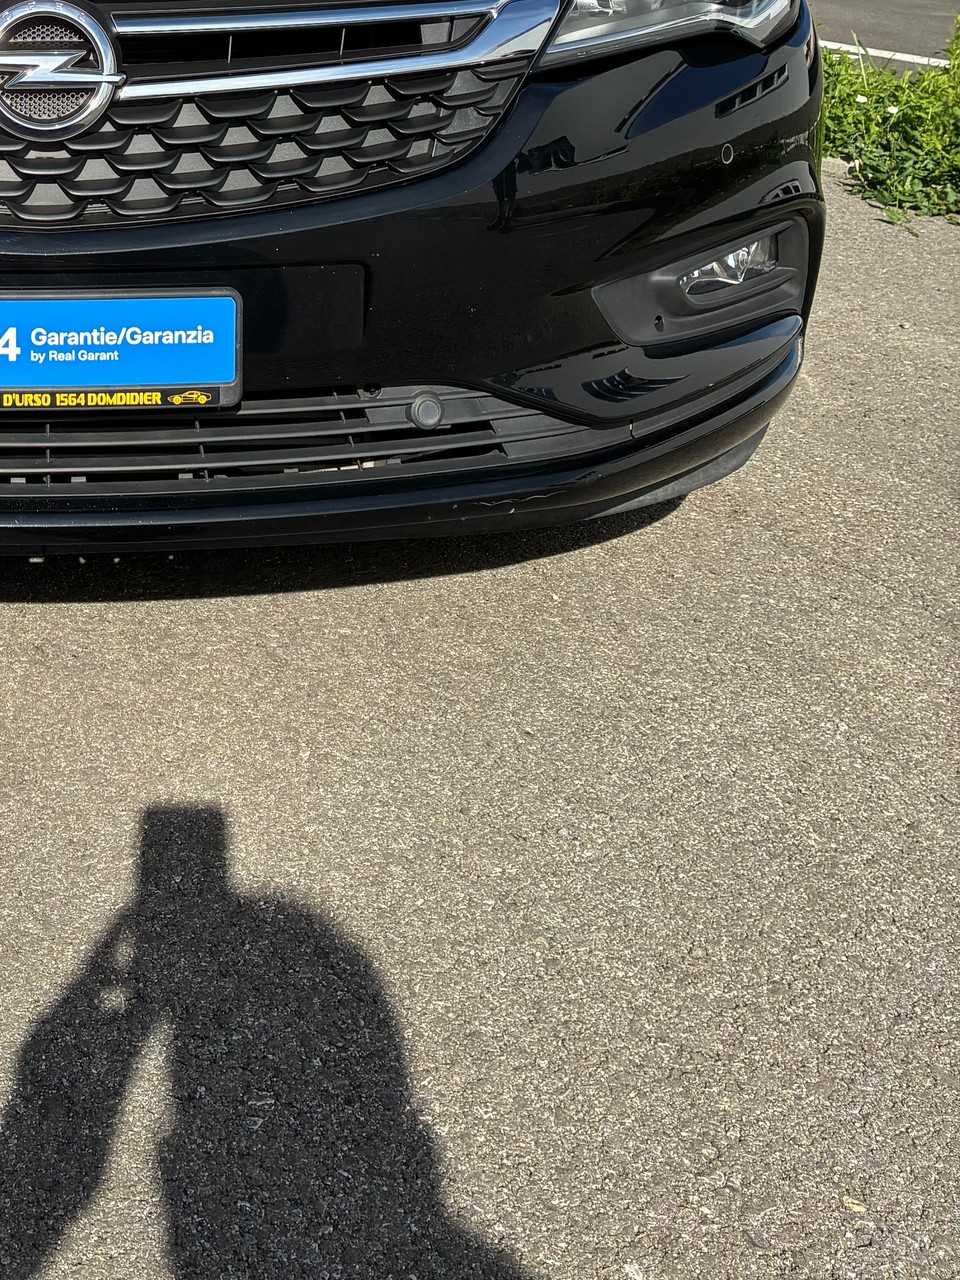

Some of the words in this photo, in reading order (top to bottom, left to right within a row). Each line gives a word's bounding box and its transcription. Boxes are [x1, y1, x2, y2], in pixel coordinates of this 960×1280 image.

[2, 1, 86, 23] OPEL
[30, 325, 214, 346] Garantie/Garanzia
[30, 350, 46, 364] by
[49, 350, 75, 362] Real
[78, 350, 119, 361] Garant
[2, 392, 51, 407] D'URSO
[55, 393, 86, 407] 1564
[87, 392, 162, 406] DOMDIDIER
